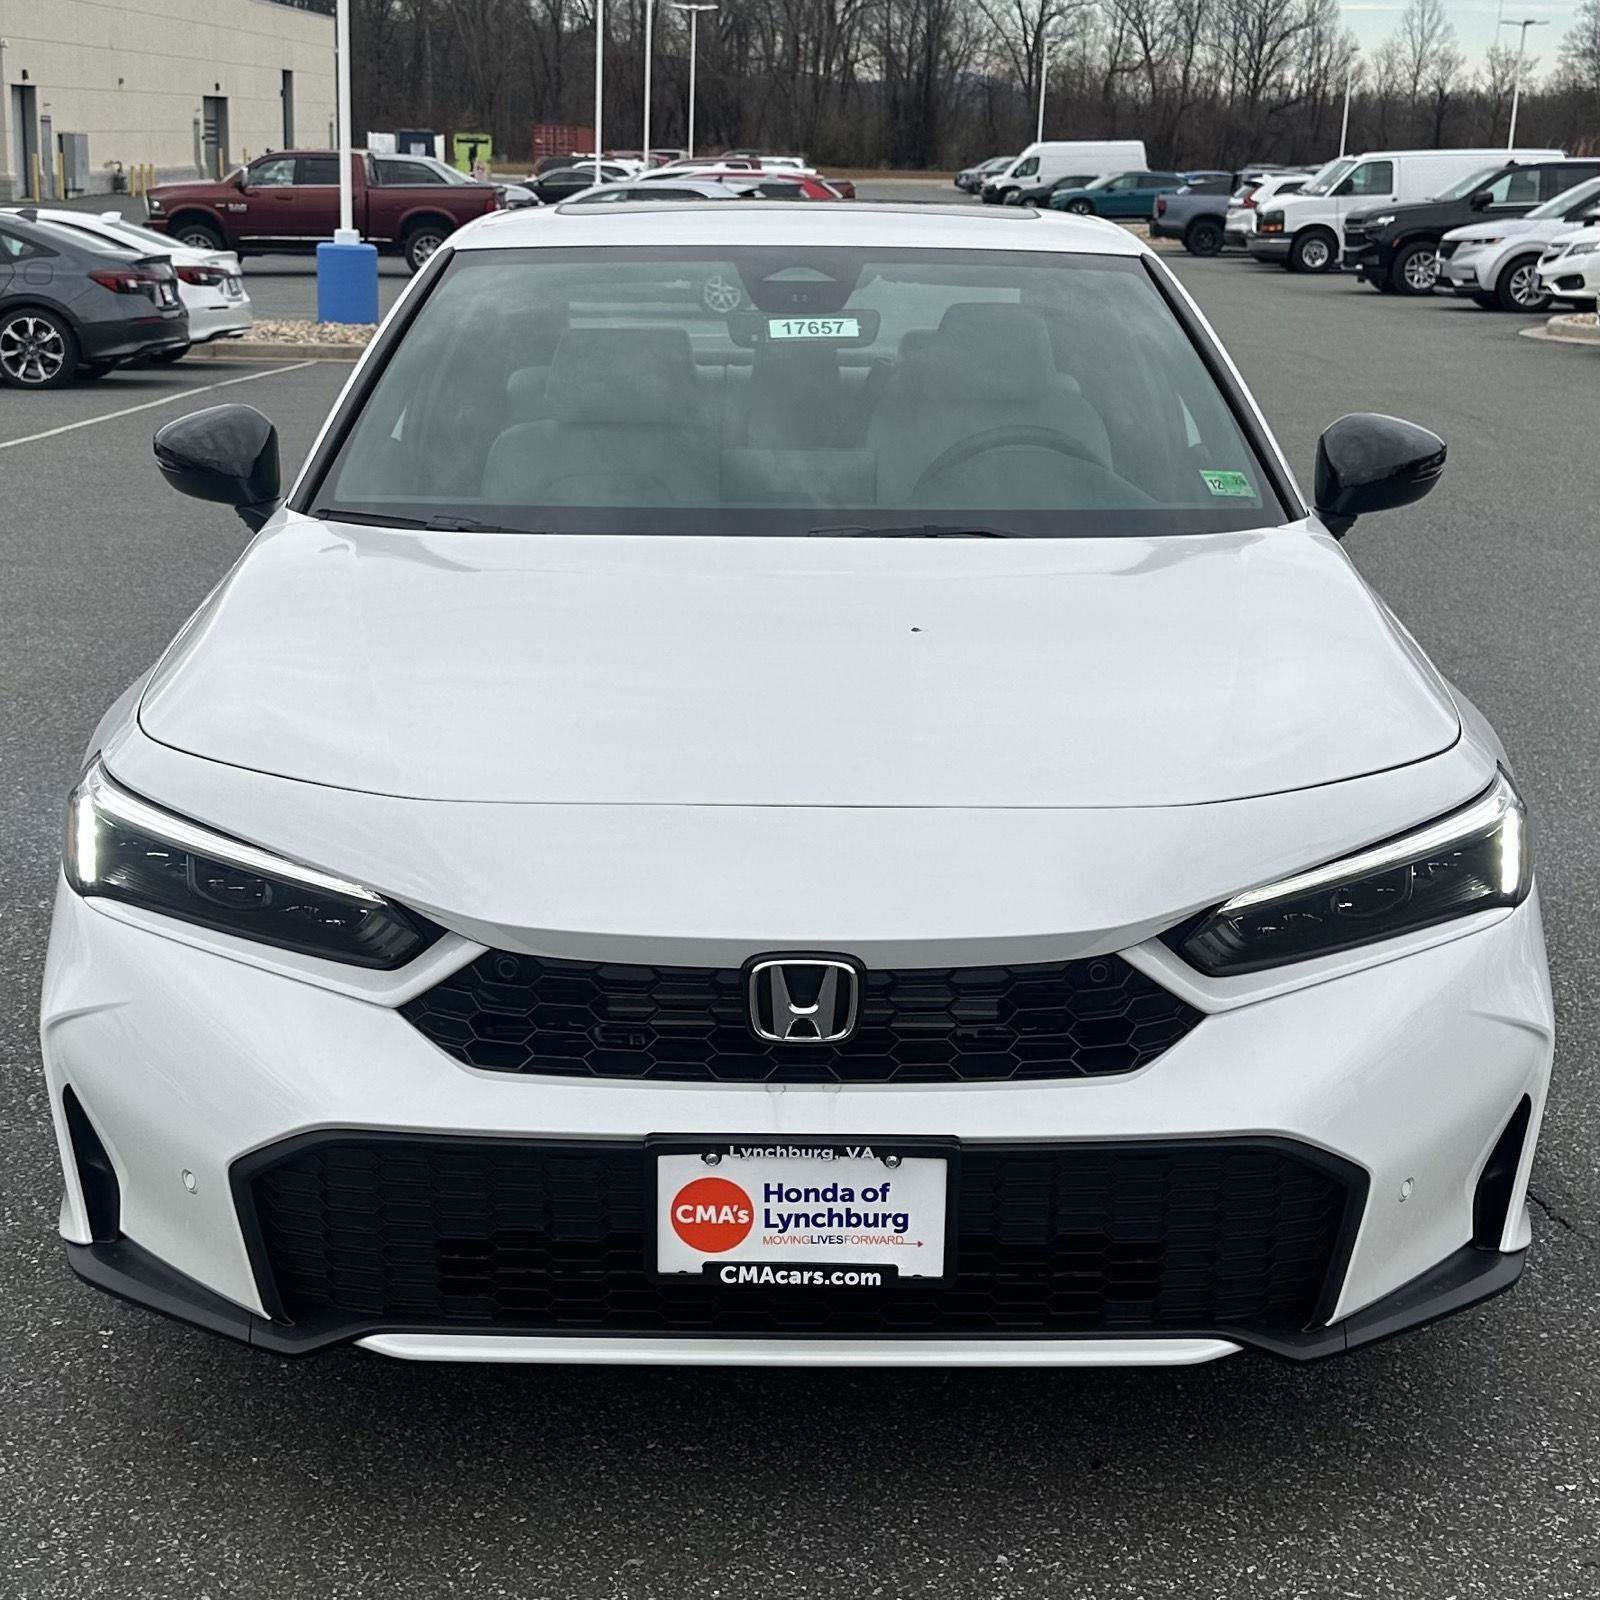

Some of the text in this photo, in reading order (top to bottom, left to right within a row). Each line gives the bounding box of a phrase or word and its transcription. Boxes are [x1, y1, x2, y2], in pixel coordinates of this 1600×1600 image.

[782, 321, 844, 335] 17657
[1209, 479, 1225, 490] 12
[729, 1145, 875, 1161] Lynchburg, VA
[763, 1183, 891, 1203] Honda of
[675, 1205, 750, 1224] CMA's
[763, 1208, 909, 1234] Lynchburg
[720, 1266, 881, 1286] CMAcars.com
